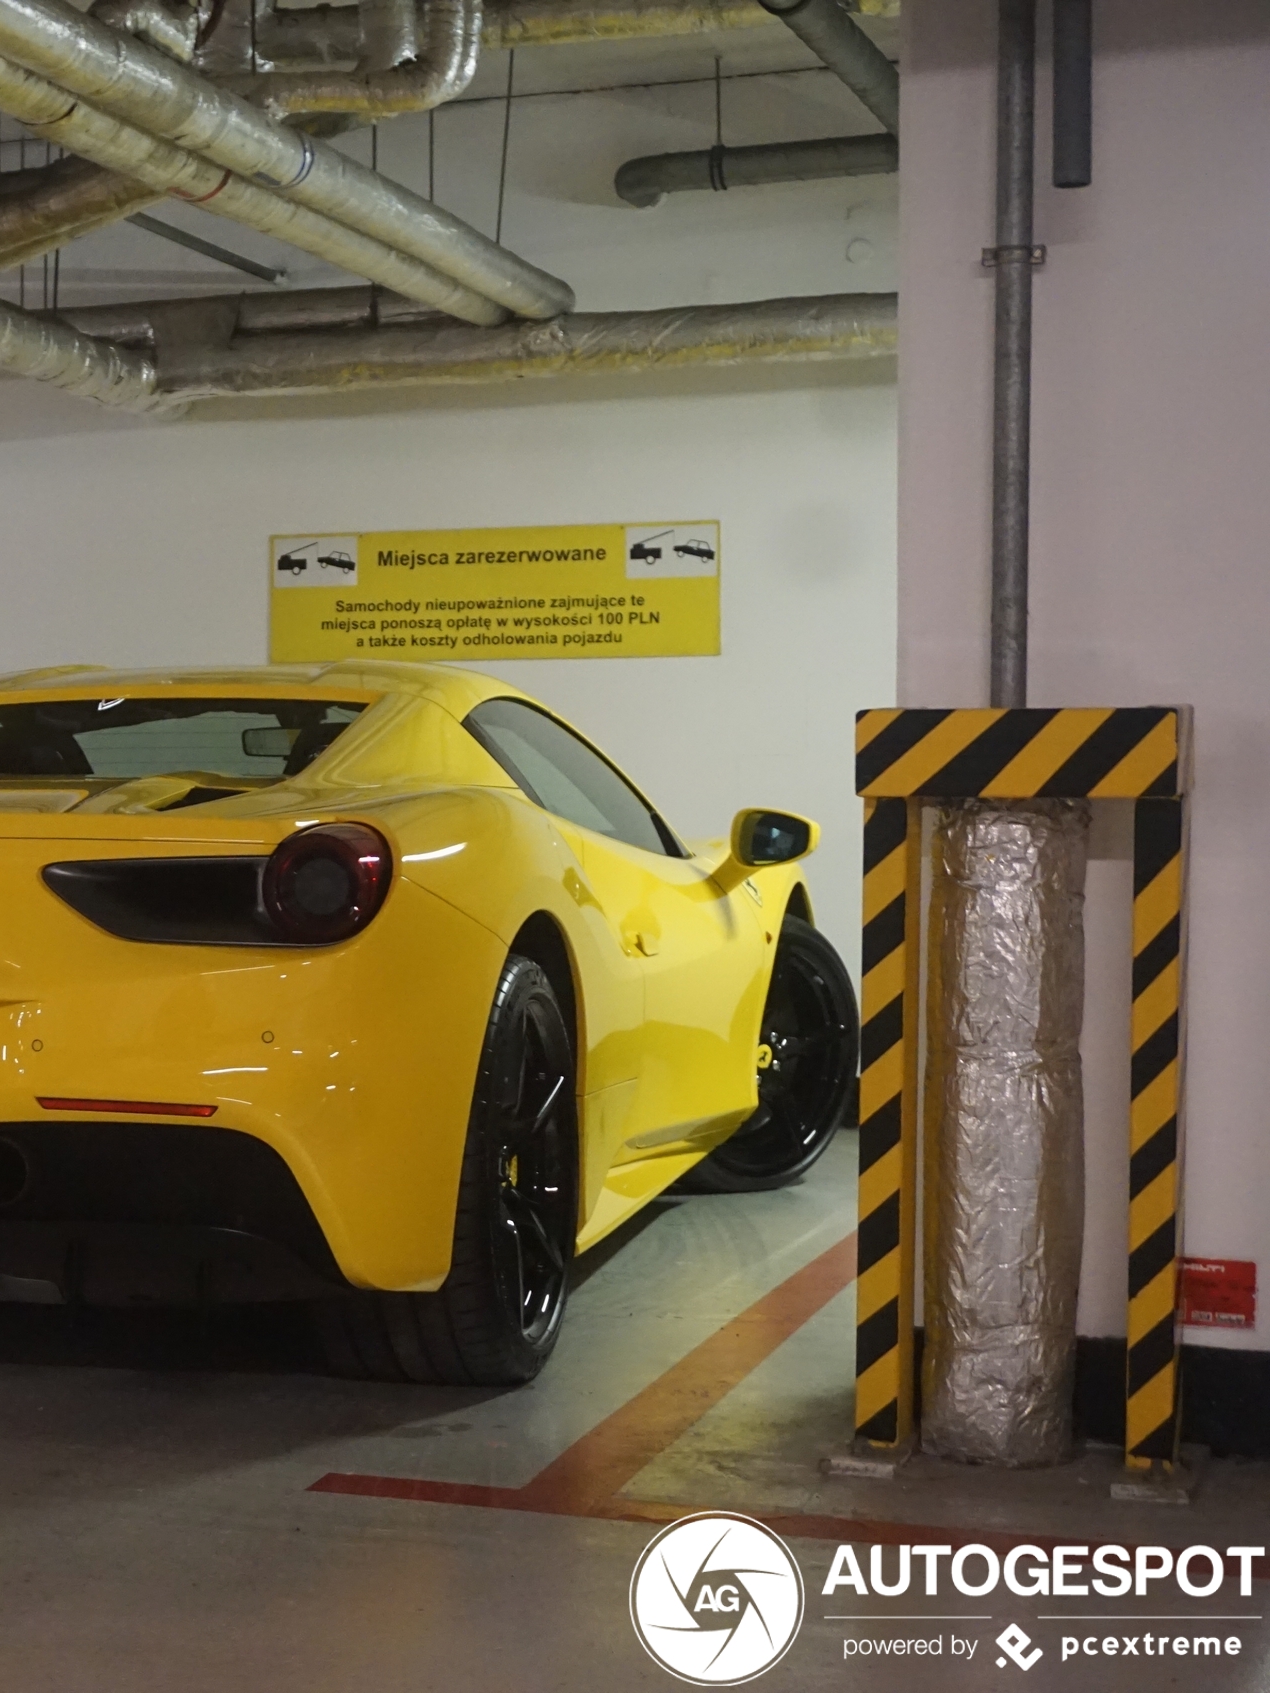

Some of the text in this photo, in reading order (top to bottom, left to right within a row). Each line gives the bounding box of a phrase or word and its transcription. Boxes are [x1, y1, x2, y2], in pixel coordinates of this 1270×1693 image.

[377, 547, 607, 570] Miejsca zarezerwowane
[335, 594, 645, 614] Samochody nieupoważnione zajmujące te
[321, 611, 660, 633] miejsca ponoszą opłatę w wysokości 100 PLN
[356, 630, 623, 649] a także koszty odholowania pojazdu
